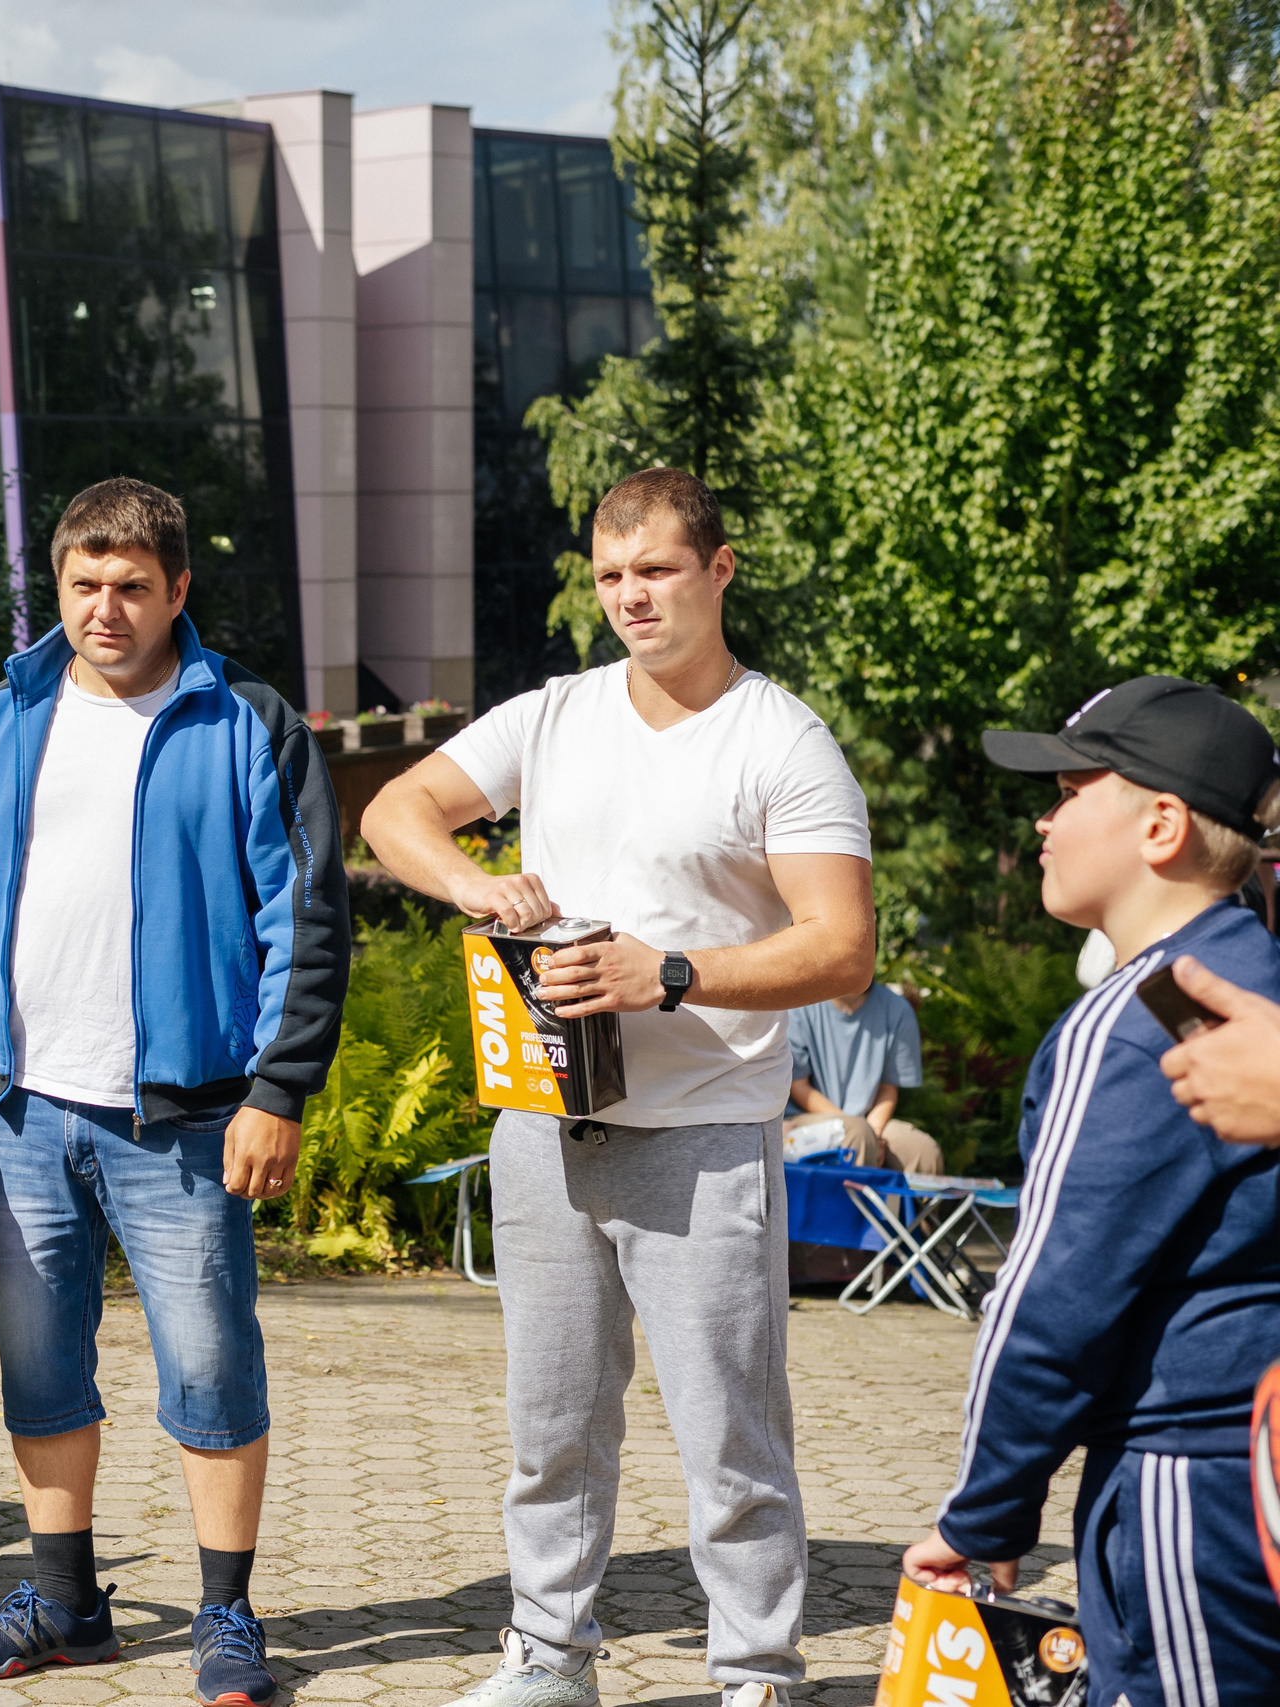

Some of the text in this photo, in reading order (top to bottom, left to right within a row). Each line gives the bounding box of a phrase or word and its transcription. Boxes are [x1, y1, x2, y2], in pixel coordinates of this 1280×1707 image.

[287, 780, 314, 908] MIXTIME SPORTS DESIGN
[469, 952, 513, 1090] TOM'S
[520, 1031, 566, 1046] PROFESSIONAL
[521, 1042, 568, 1068] 0W-20
